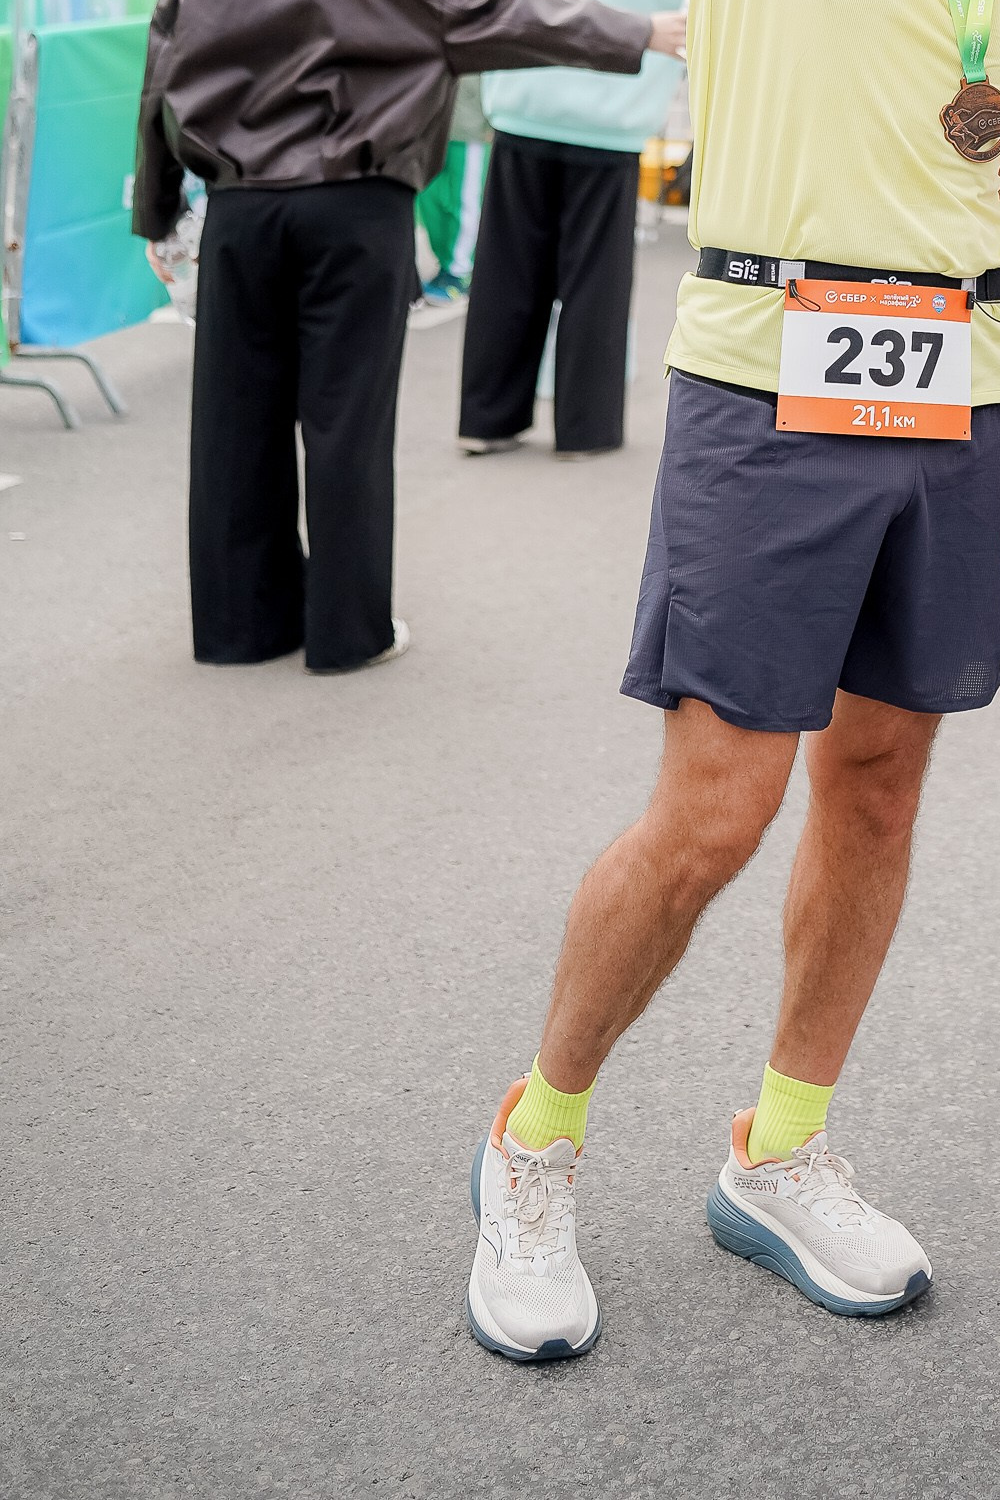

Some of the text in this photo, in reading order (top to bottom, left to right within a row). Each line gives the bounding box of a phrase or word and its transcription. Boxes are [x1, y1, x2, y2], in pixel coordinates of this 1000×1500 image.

[840, 293, 867, 303] СБЕР
[824, 326, 944, 389] 237
[851, 404, 890, 431] 21,1
